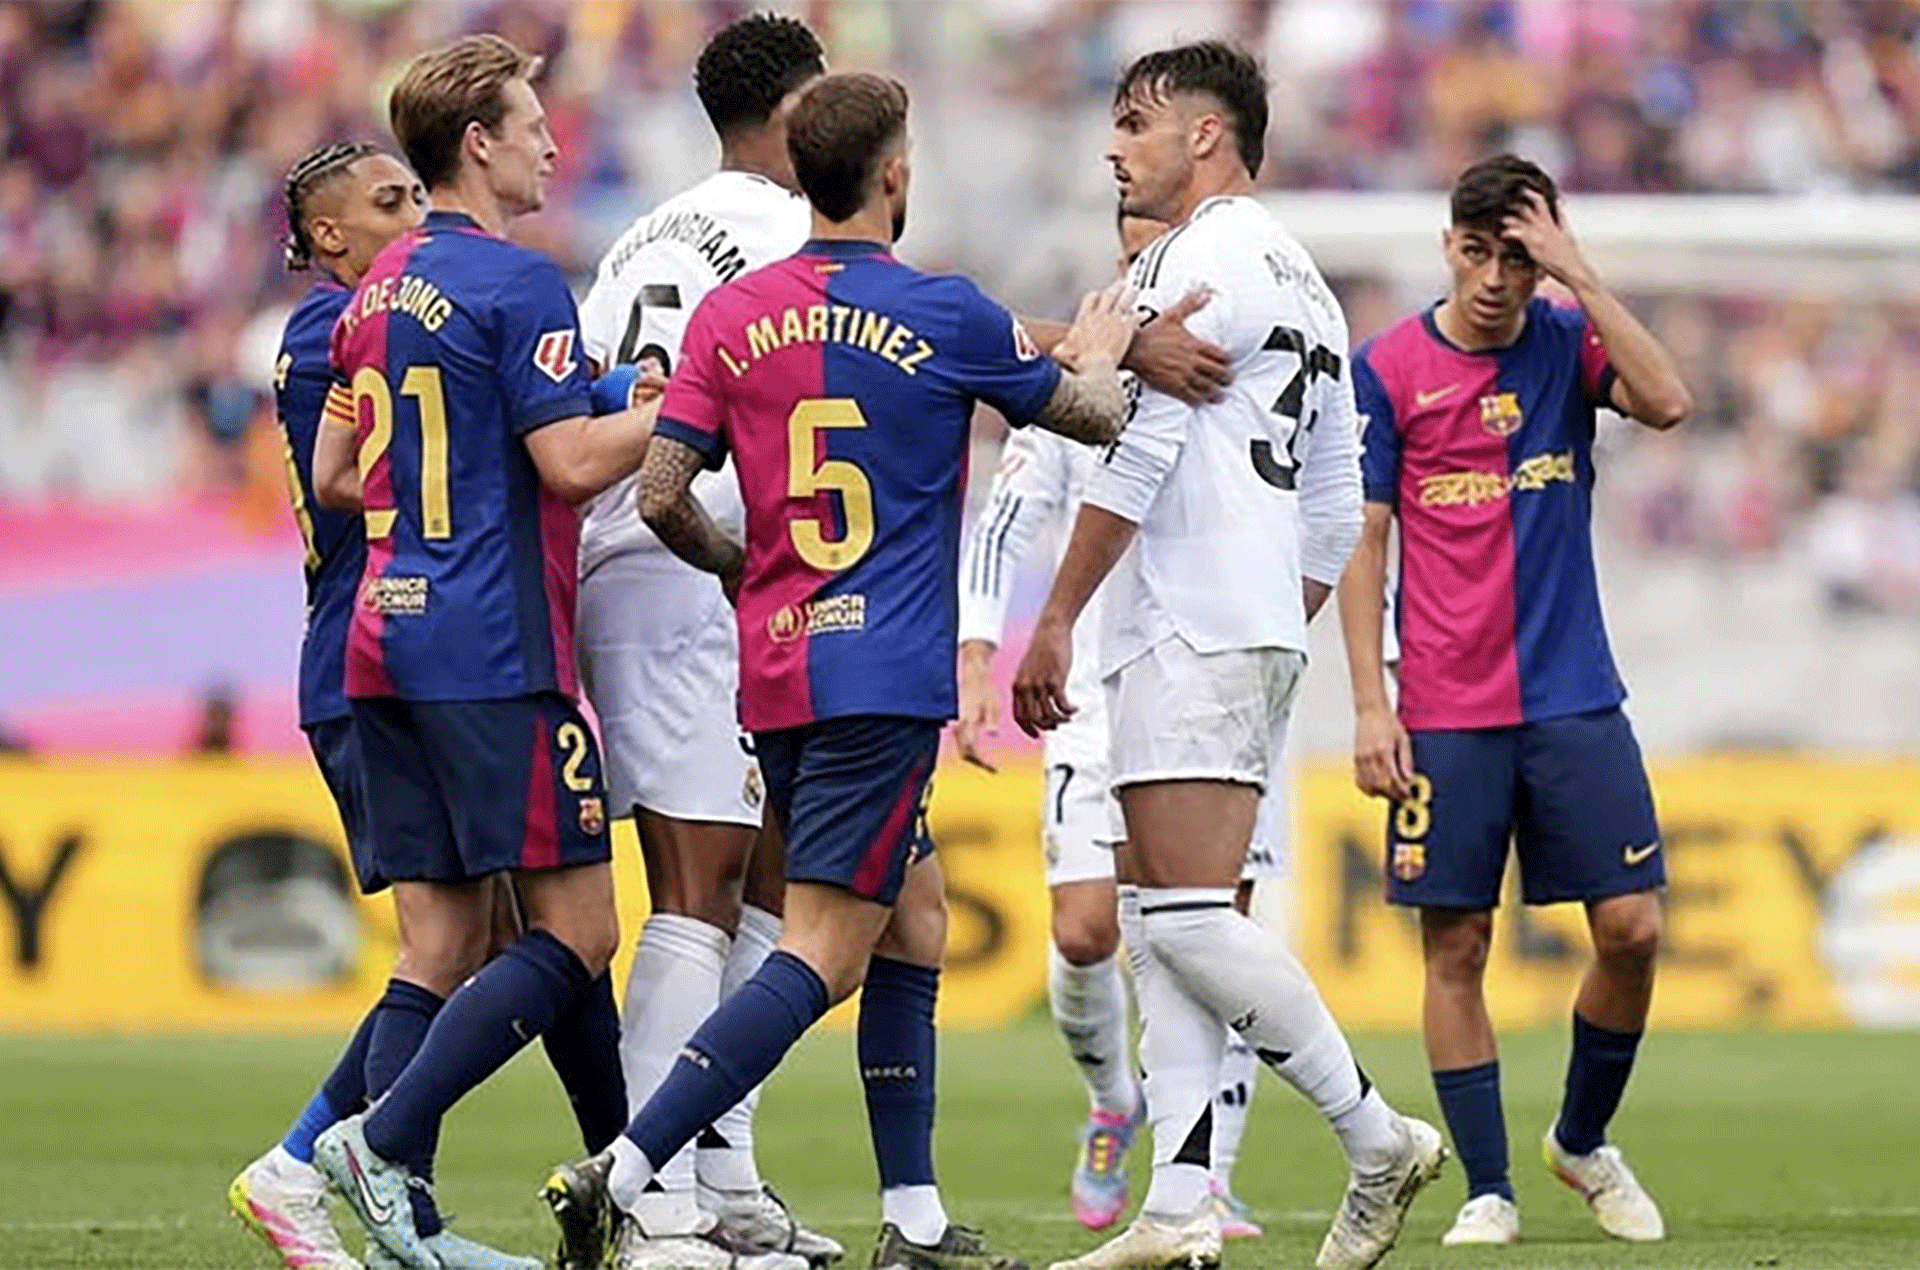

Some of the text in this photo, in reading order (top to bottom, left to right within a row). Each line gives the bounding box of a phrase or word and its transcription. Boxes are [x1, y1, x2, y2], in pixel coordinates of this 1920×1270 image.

[717, 304, 934, 378] I. MARTINEZ
[351, 366, 453, 540] 21
[786, 398, 874, 571] 5
[556, 721, 593, 792] 2
[1053, 762, 1076, 824] 7
[1396, 773, 1432, 840] 8
[0, 828, 84, 970] Y
